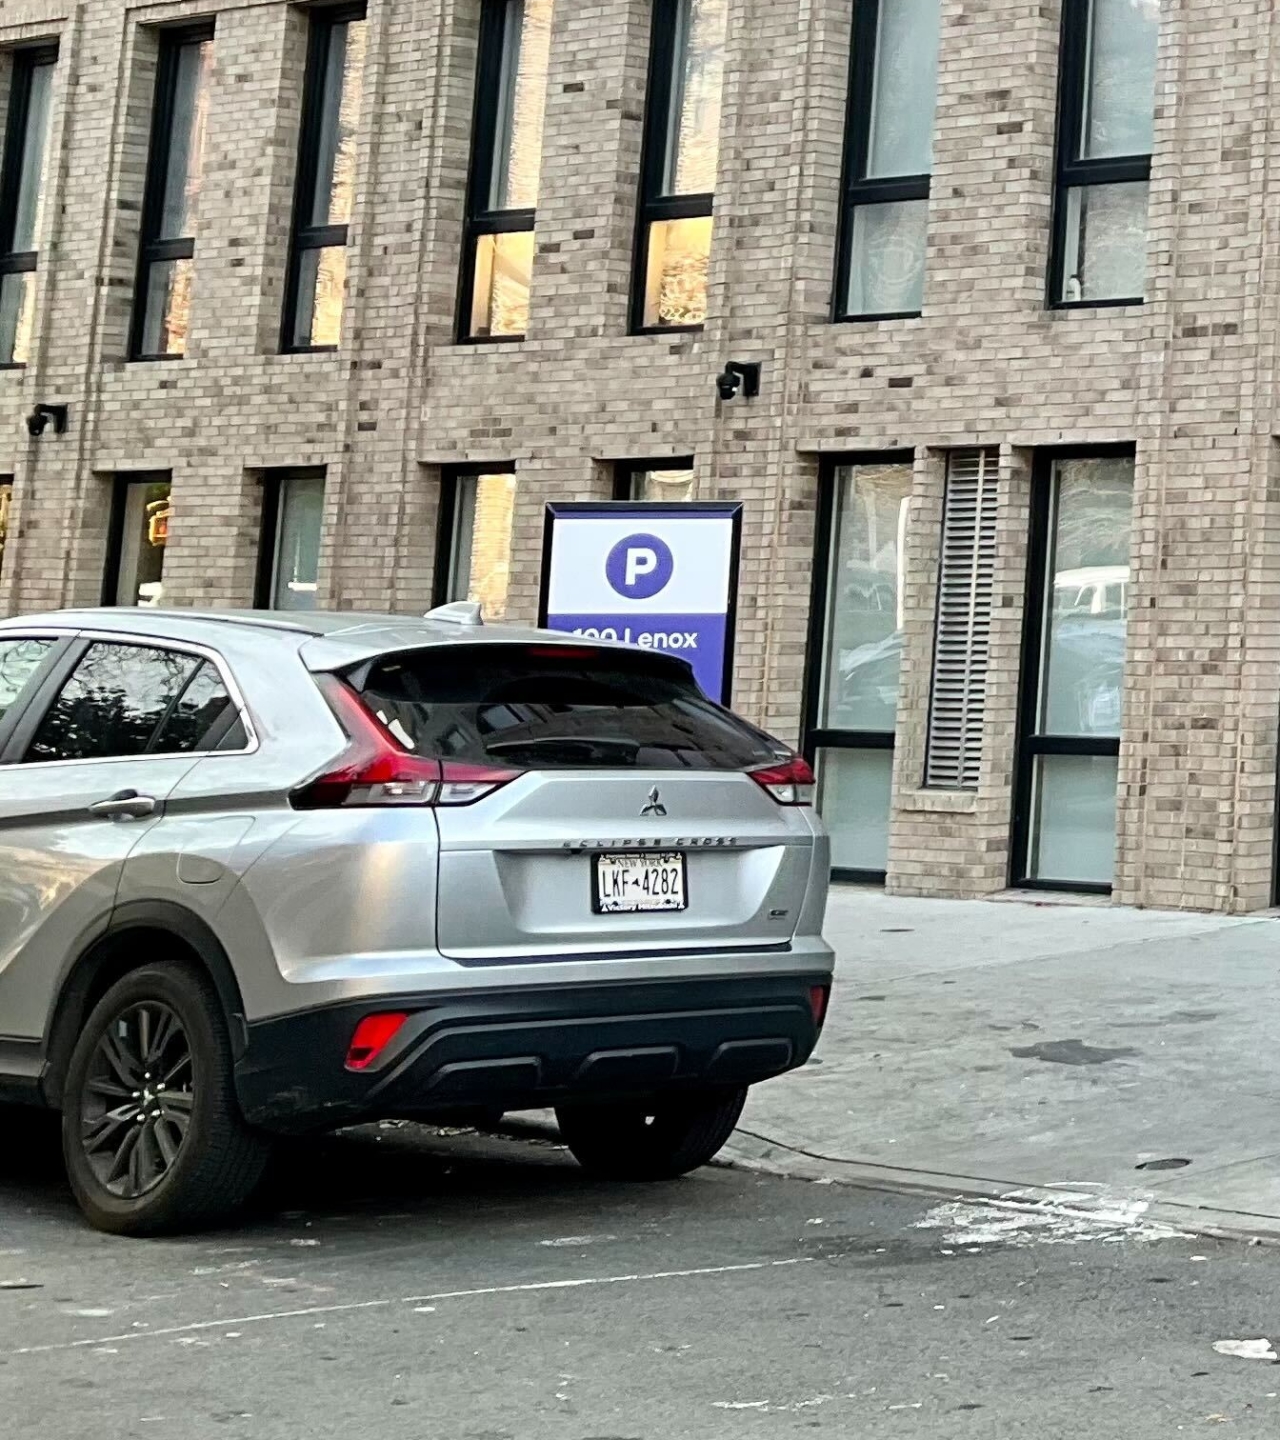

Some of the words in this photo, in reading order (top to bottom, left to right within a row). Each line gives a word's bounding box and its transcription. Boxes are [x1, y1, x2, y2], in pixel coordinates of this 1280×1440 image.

[625, 548, 657, 585] P
[563, 838, 662, 848] ECLIPSE
[676, 836, 738, 847] CROSS
[618, 859, 637, 868] NEW
[640, 859, 663, 868] YORK
[602, 869, 630, 898] LKF
[642, 868, 679, 895] 4282
